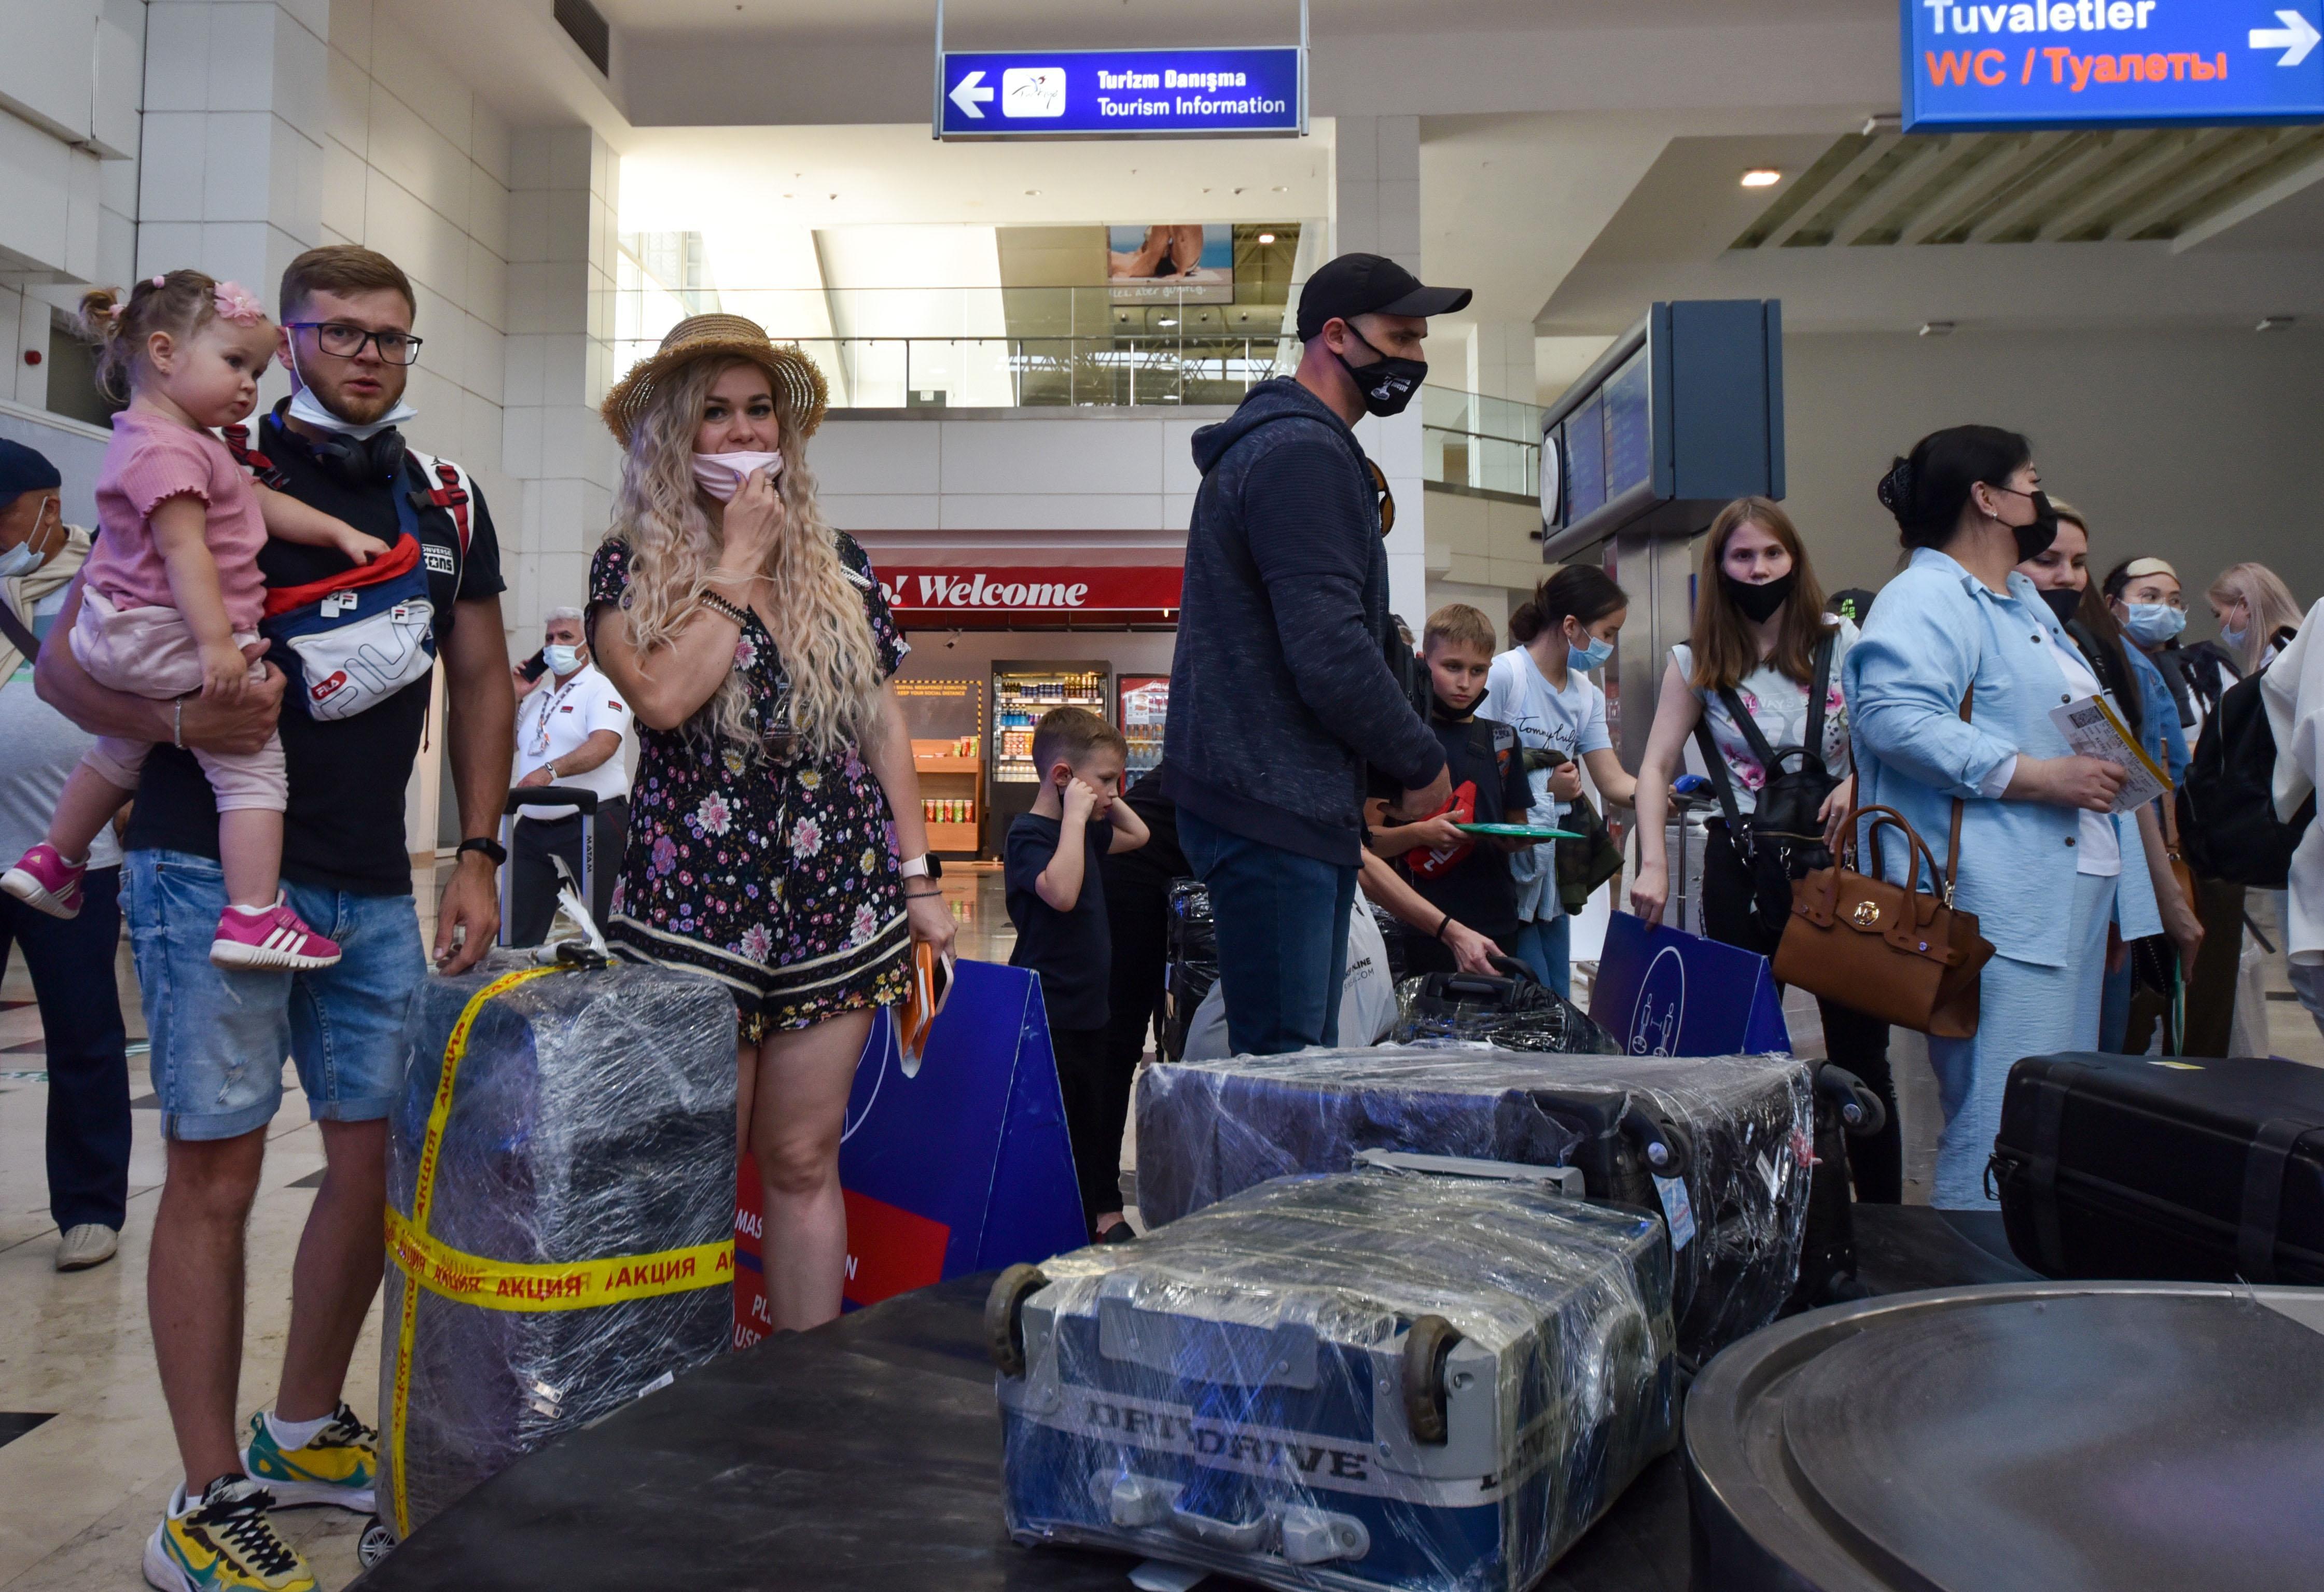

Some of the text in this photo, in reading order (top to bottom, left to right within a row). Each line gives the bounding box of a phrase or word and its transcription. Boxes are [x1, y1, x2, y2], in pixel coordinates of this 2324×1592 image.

[1924, 0, 2156, 33] Tuvaletler
[1098, 70, 1246, 92] Turizm Danışma
[1926, 48, 2228, 92] WC / Туалеты
[1098, 95, 1285, 116] Tourism Information
[422, 546, 452, 556] ONVERSE
[919, 574, 1088, 606] Welcome
[315, 679, 340, 697] FILA
[1515, 716, 1554, 750] Tommy
[1424, 846, 1460, 871] FIL
[734, 1209, 762, 1239] MAS
[496, 1274, 581, 1302] АКЦИЯ
